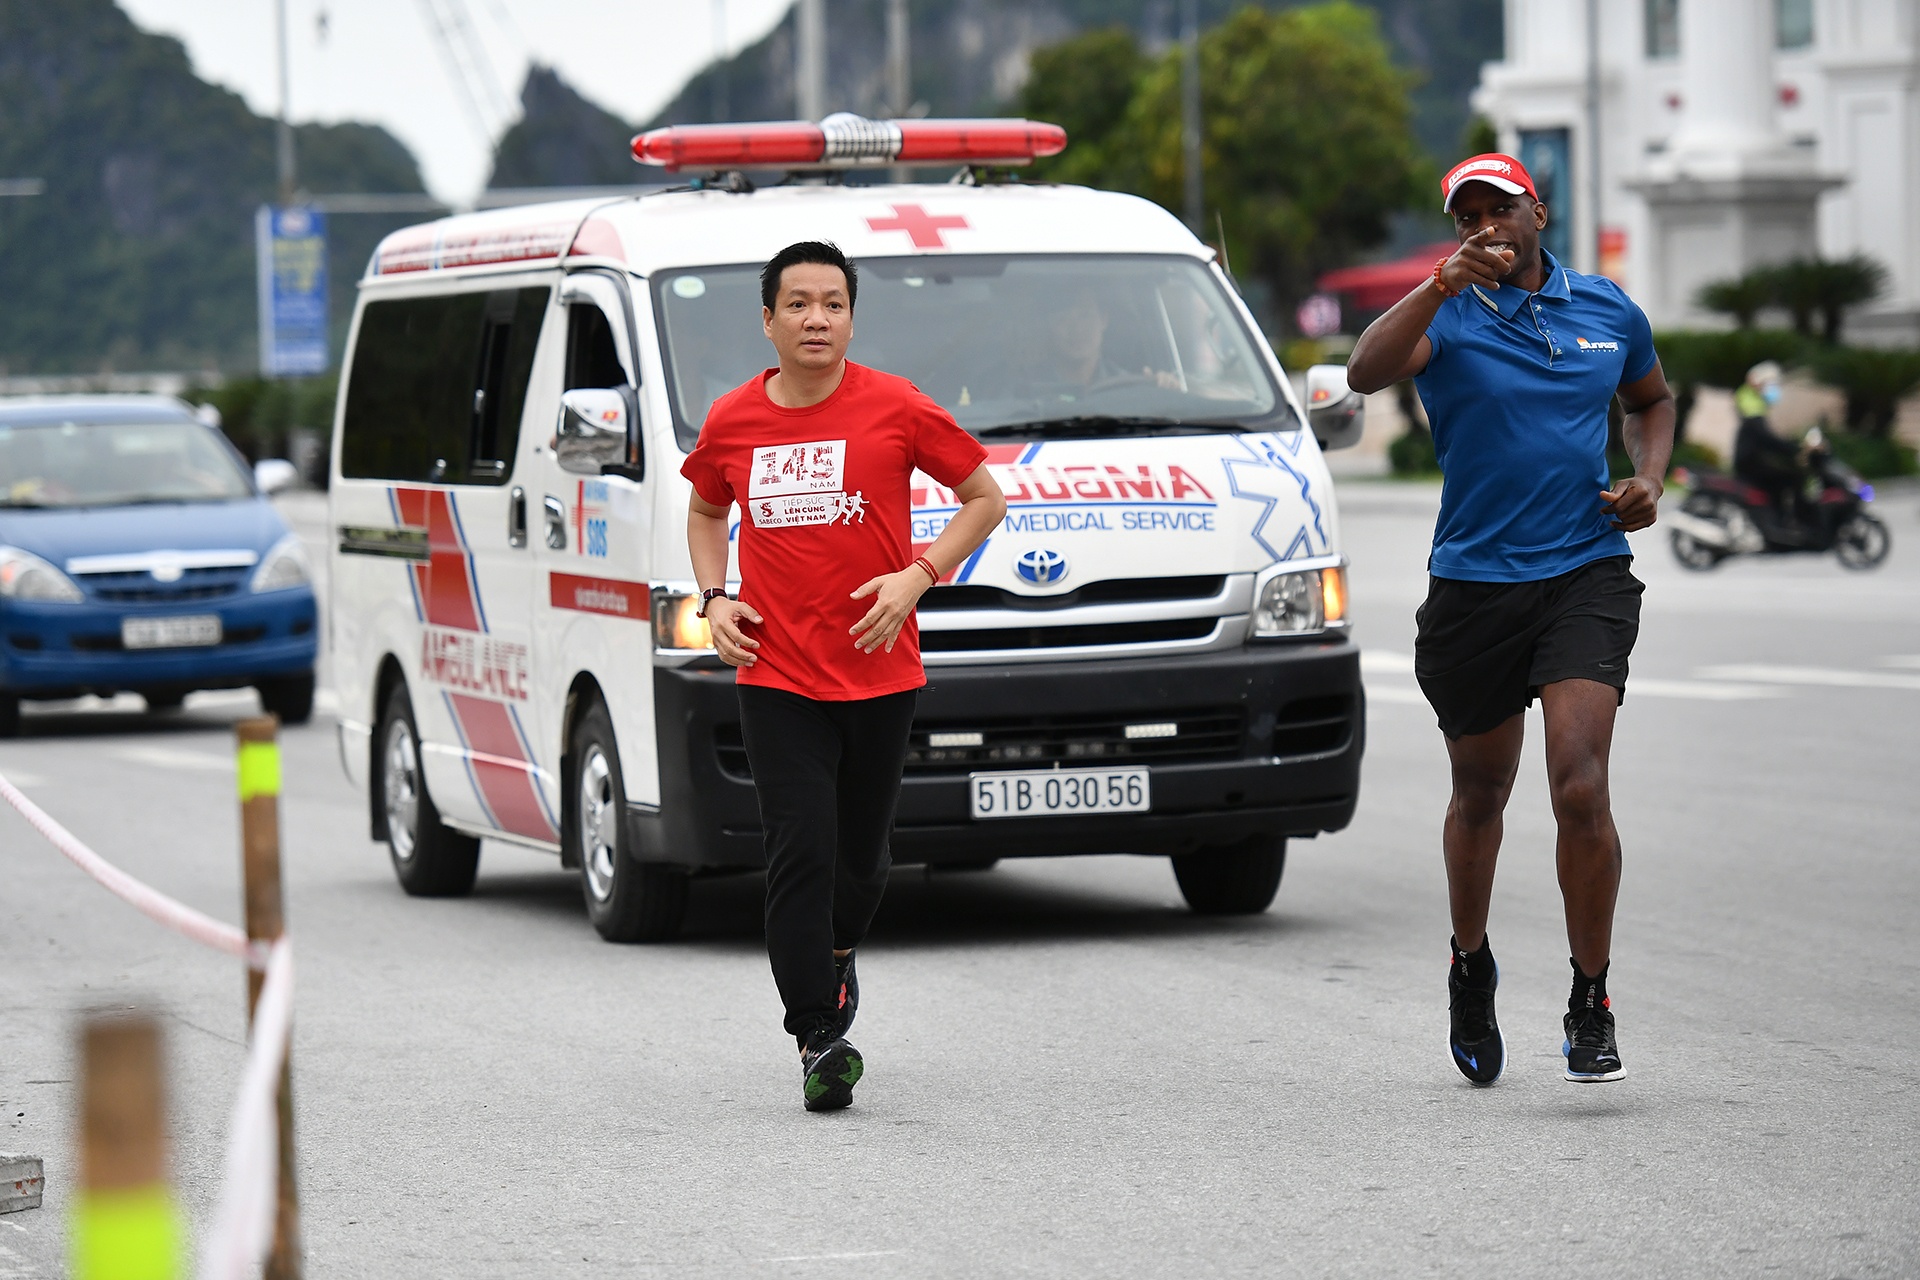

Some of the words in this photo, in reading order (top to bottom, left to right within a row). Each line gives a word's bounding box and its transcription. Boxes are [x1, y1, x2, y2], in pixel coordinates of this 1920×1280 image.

[759, 517, 783, 525] SABECO
[785, 515, 805, 525] VIỆT
[1005, 511, 1114, 533] MEDICAL
[1121, 511, 1216, 532] SERVICE
[587, 518, 608, 558] SOS
[421, 628, 528, 701] AMBULANCE
[978, 774, 1143, 813] 51B-030.56
